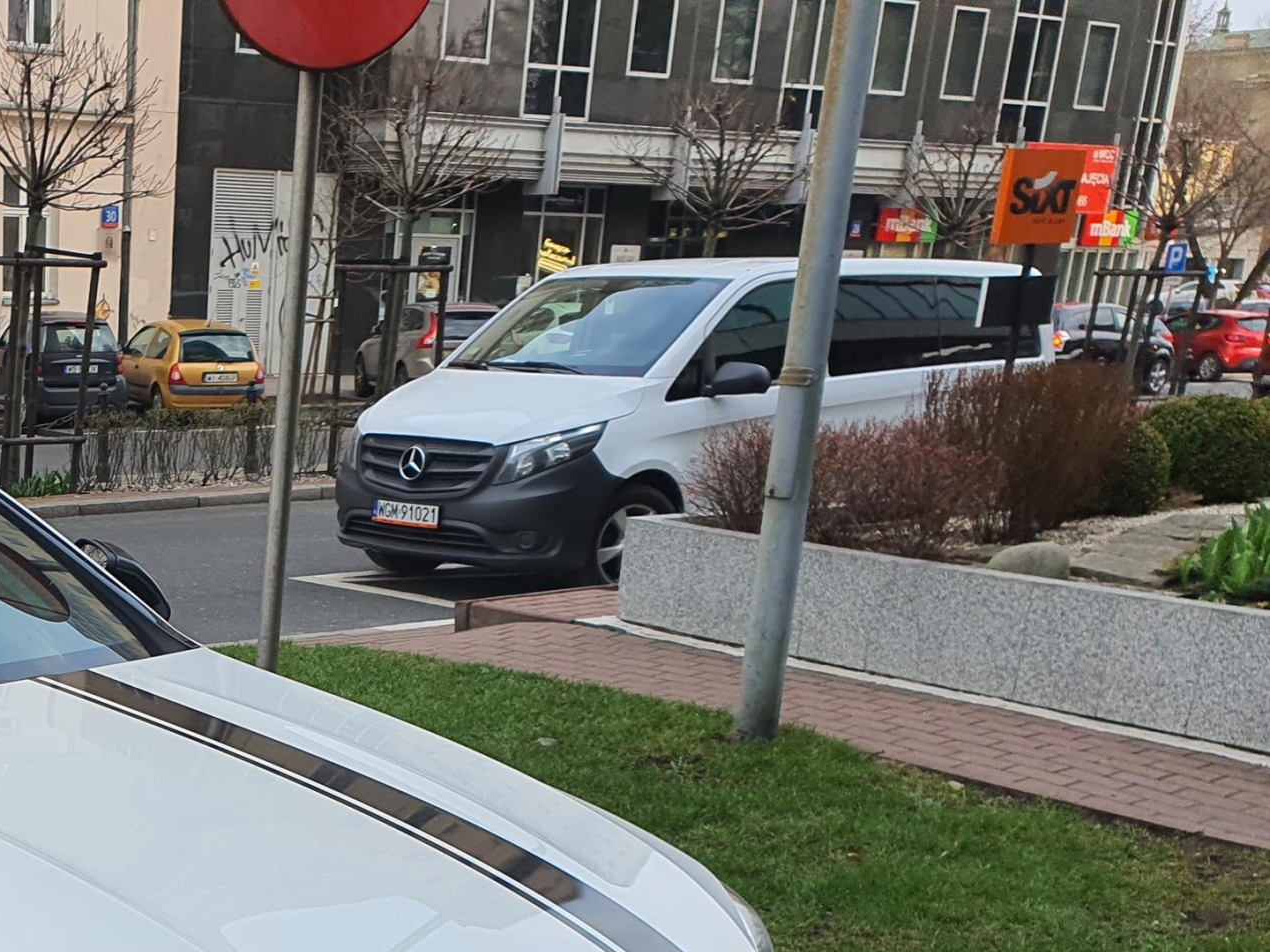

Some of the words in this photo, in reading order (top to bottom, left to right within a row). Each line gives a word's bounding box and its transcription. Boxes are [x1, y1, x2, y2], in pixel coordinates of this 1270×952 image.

[105, 210, 117, 222] 30
[1090, 219, 1132, 237] mBank
[1168, 246, 1183, 269] P
[401, 502, 436, 523] 91021
